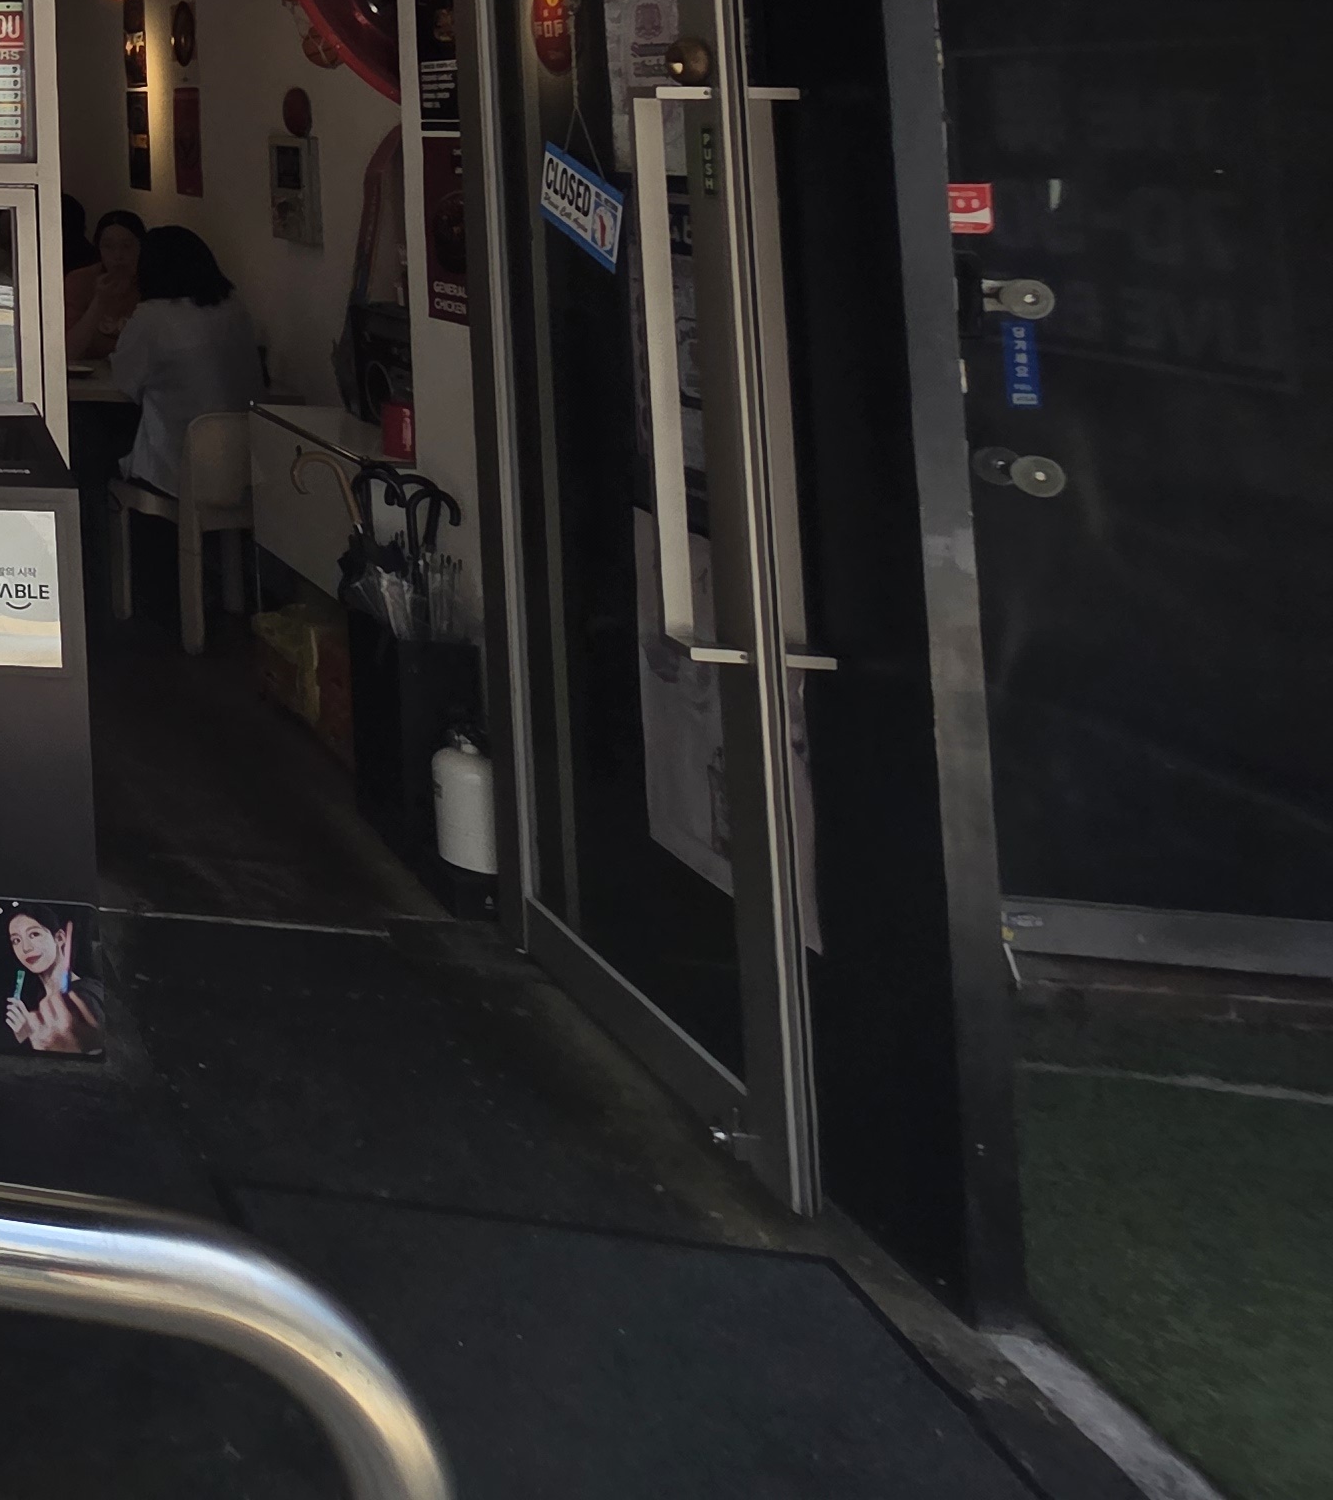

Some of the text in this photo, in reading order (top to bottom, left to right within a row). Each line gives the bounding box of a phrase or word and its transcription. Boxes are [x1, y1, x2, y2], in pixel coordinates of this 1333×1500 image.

[702, 133, 714, 190] PUSH
[545, 157, 592, 217] CLOSED
[434, 298, 468, 315] CHICKEN
[17, 566, 37, 578] 시작
